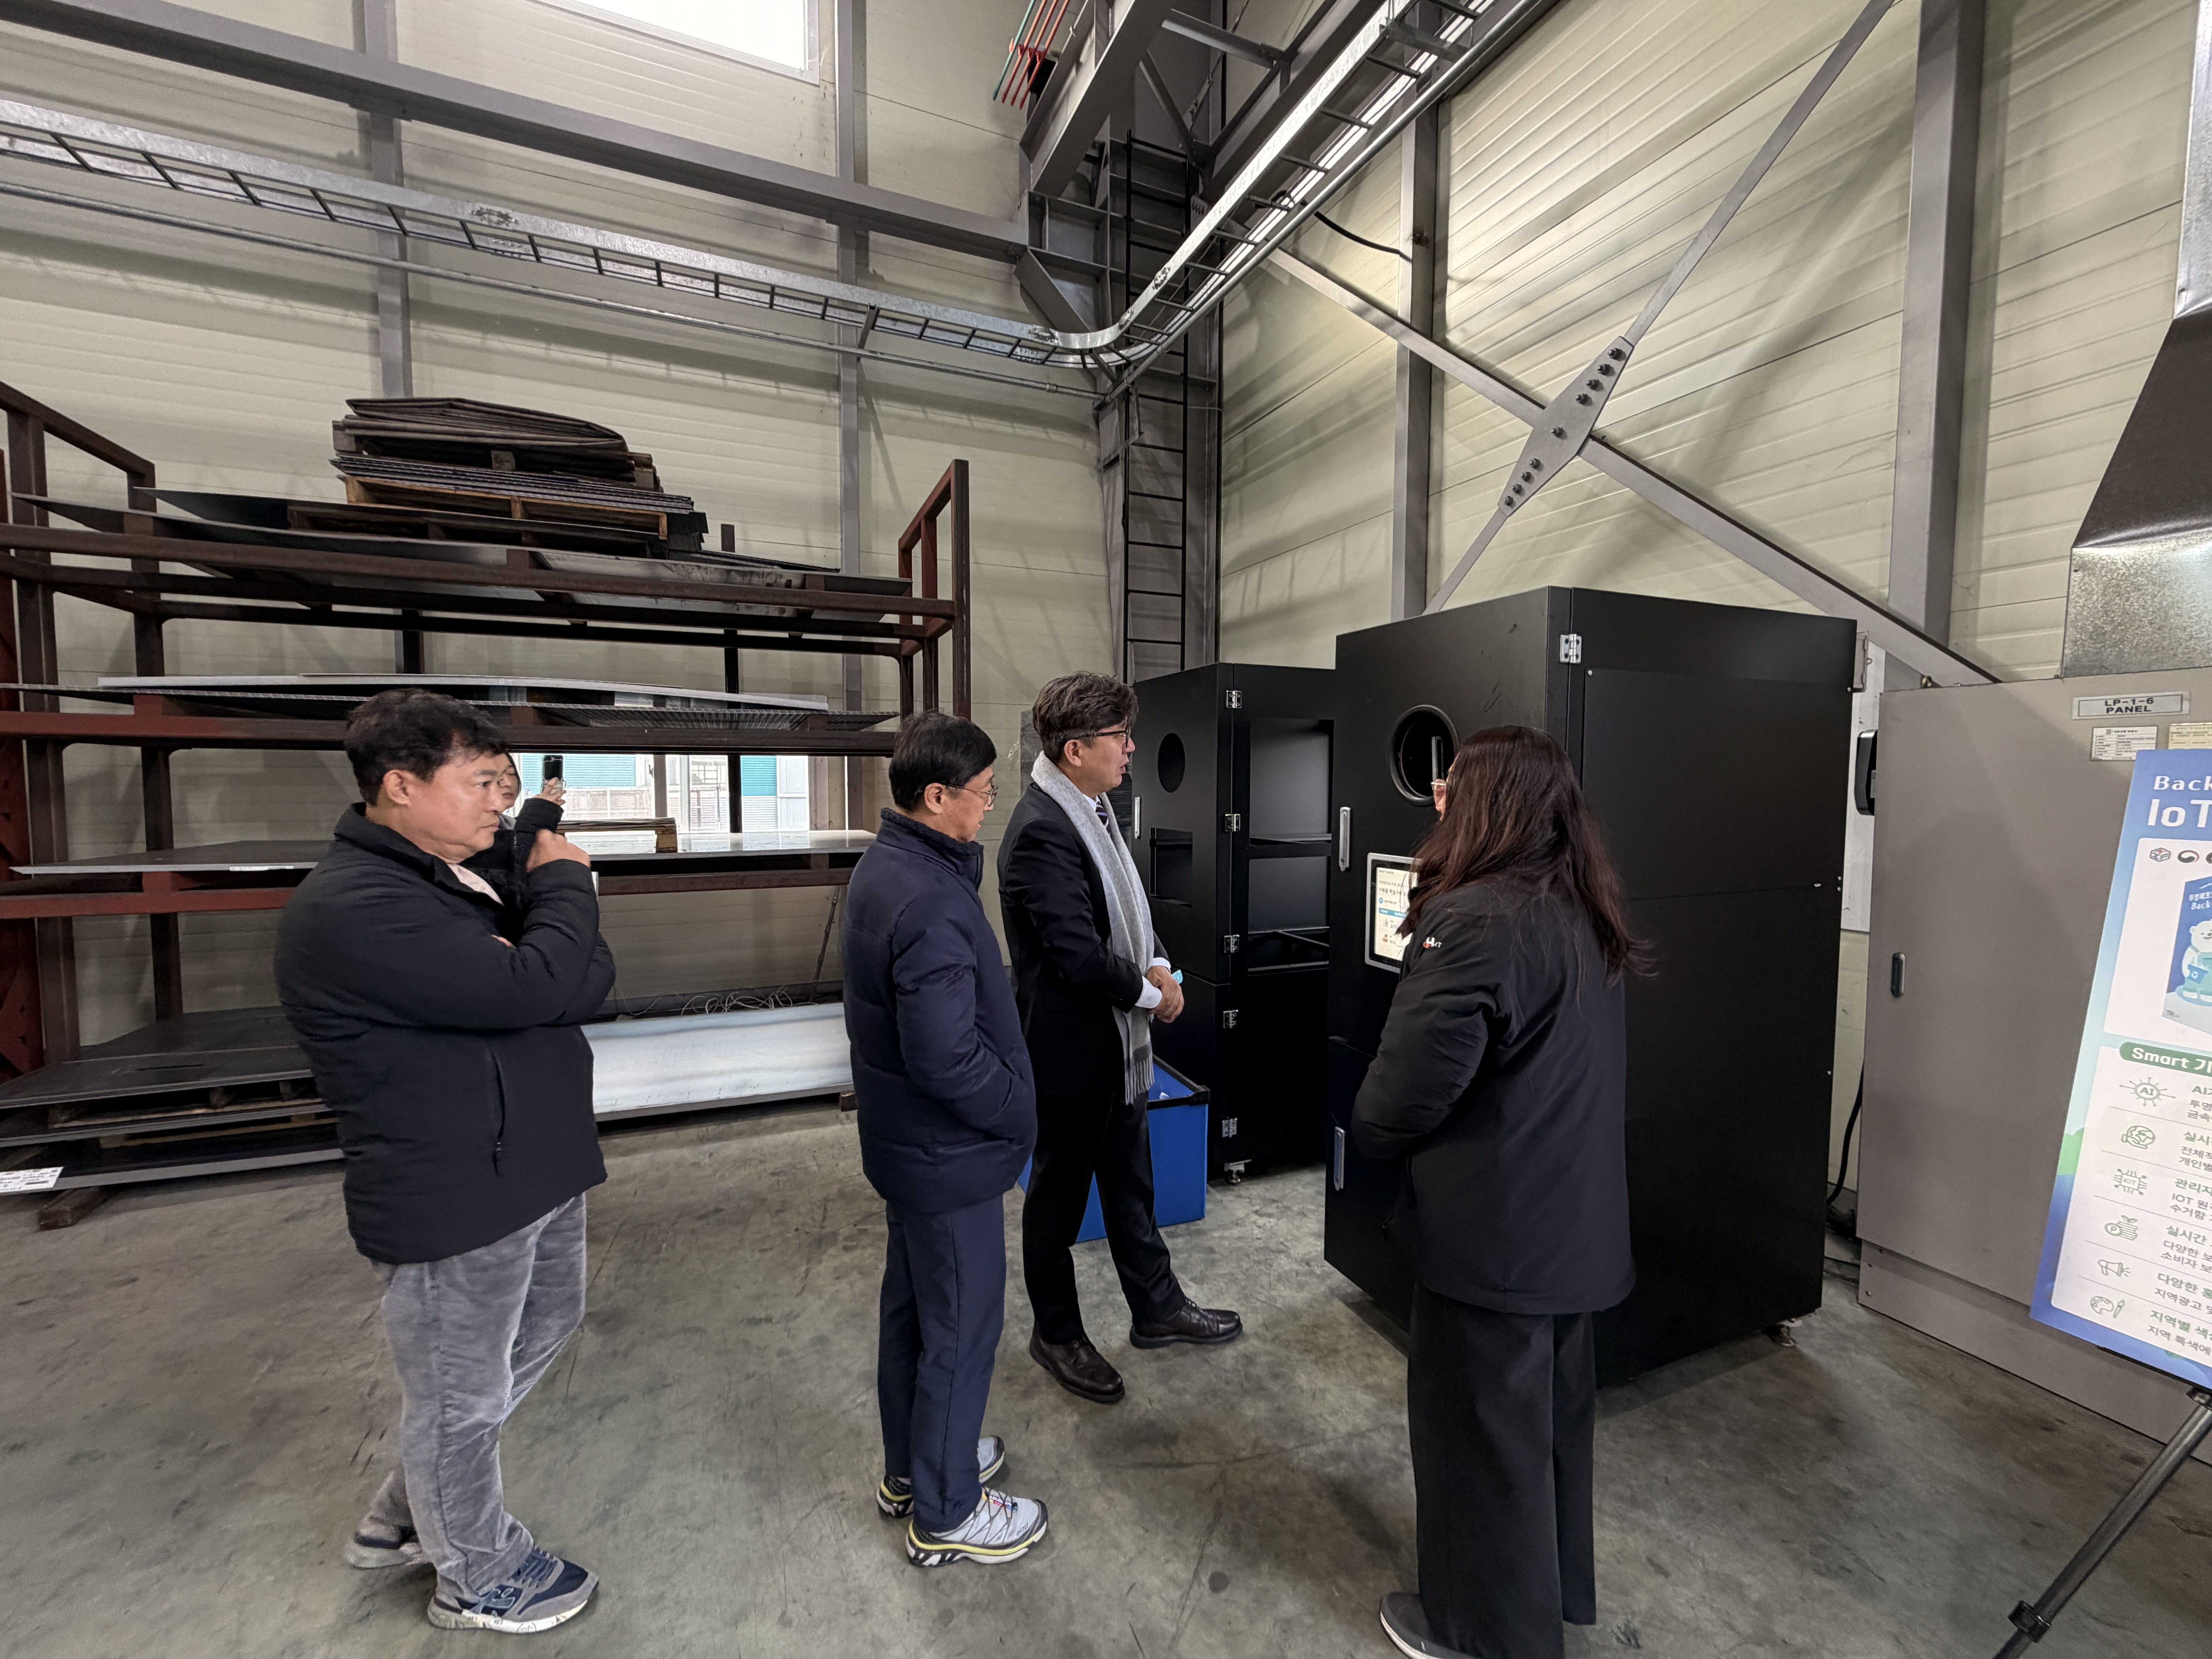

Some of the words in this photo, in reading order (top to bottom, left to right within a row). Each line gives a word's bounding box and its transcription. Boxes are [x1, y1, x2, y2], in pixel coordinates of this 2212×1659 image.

[2105, 697, 2154, 706] LP-1-6
[2106, 706, 2152, 714] PANEL
[2154, 776, 2212, 790] Back
[2147, 799, 2212, 827] IoT
[2191, 900, 2212, 910] Back
[2132, 1047, 2190, 1068] Smart
[2194, 1058, 2212, 1073] 기
[2140, 1087, 2154, 1096] AI
[2187, 1109, 2212, 1122] 금속
[2184, 1131, 2212, 1146] 실시
[2170, 1204, 2206, 1220] 수거함
[2166, 1225, 2207, 1245] 실시간
[2163, 1240, 2200, 1258] 다양한
[2160, 1252, 2198, 1269] 소비자
[2157, 1273, 2198, 1294] 다양한
[2154, 1288, 2202, 1310] 지역광고
[2150, 1310, 2191, 1333] 지역별
[2147, 1325, 2171, 1341] 지역
